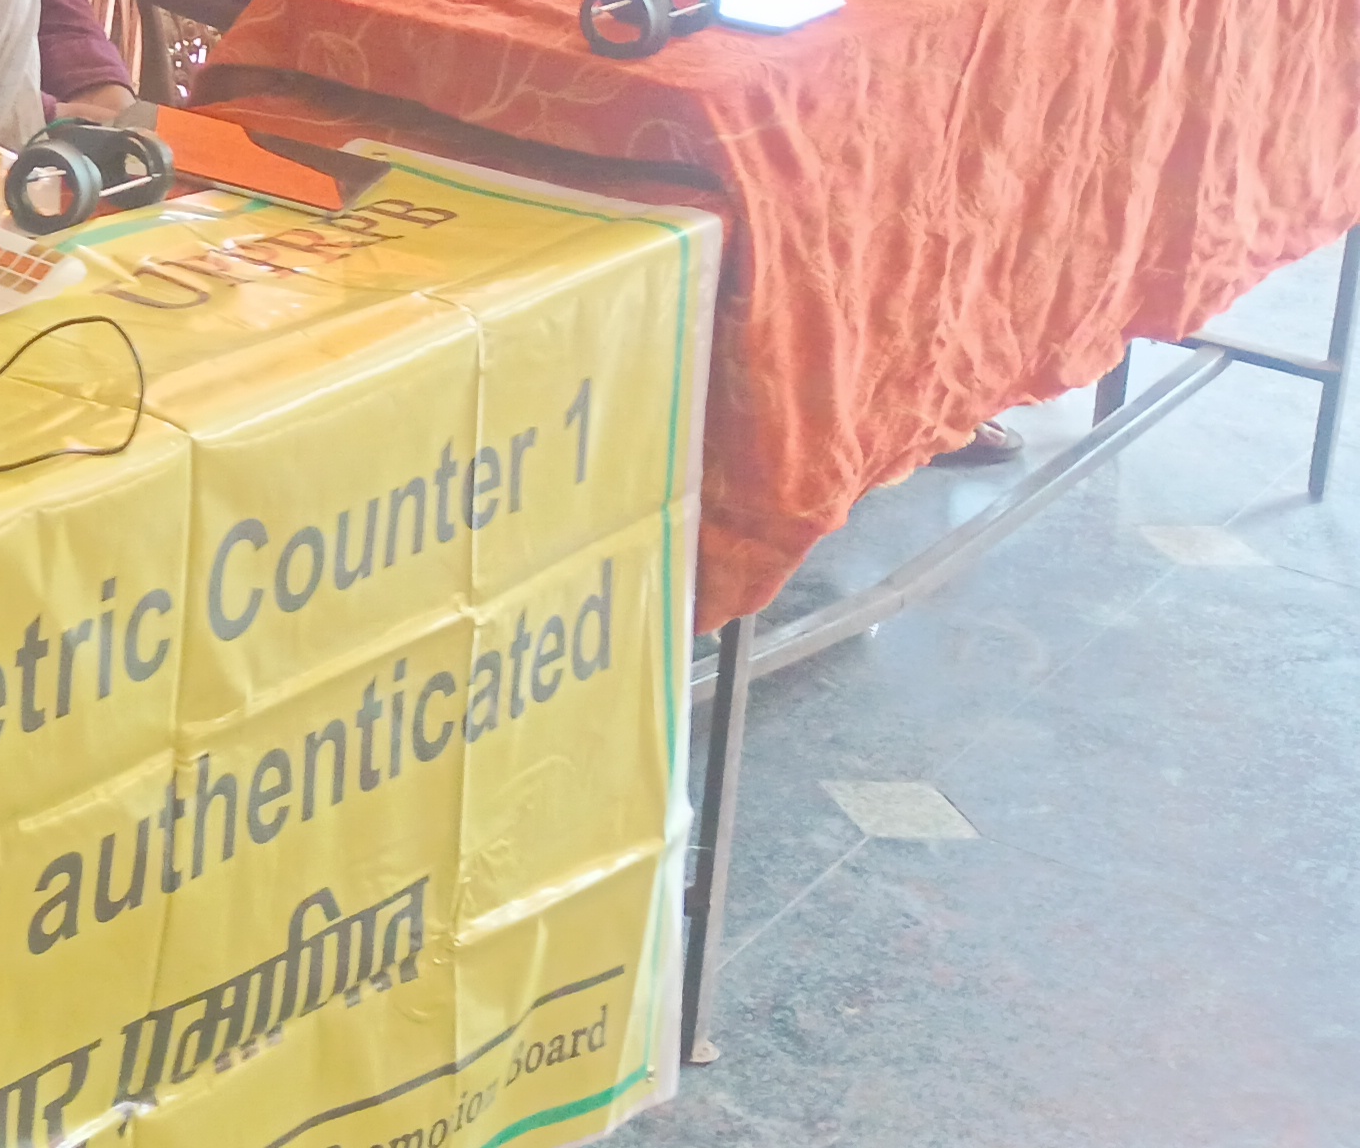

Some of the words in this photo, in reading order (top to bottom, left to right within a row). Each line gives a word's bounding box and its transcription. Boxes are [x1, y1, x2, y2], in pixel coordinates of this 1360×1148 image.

[207, 440, 537, 643] Counter
[564, 378, 592, 485] 1
[27, 557, 614, 956] authenticated
